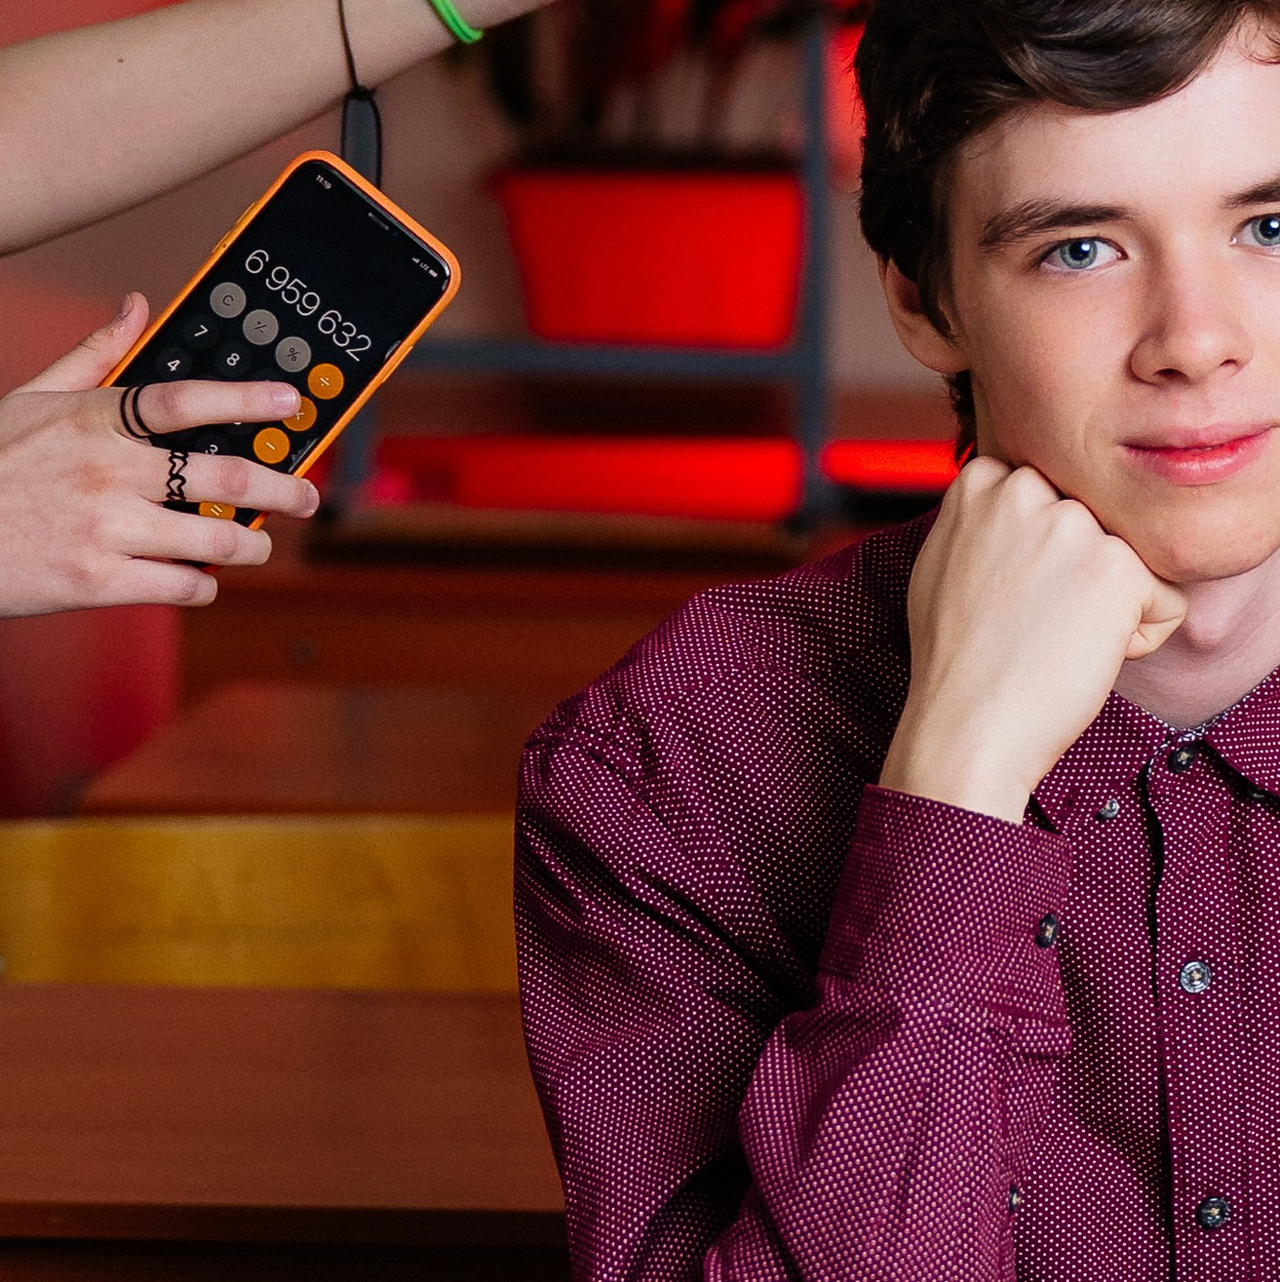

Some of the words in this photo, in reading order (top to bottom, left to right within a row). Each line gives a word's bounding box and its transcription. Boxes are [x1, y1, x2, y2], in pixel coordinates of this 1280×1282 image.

[222, 294, 234, 307] C
[245, 249, 269, 274] 6
[265, 266, 321, 316] 959
[318, 309, 373, 362] 632
[194, 325, 208, 339] 7
[226, 352, 240, 367] 8
[167, 358, 181, 372] 4
